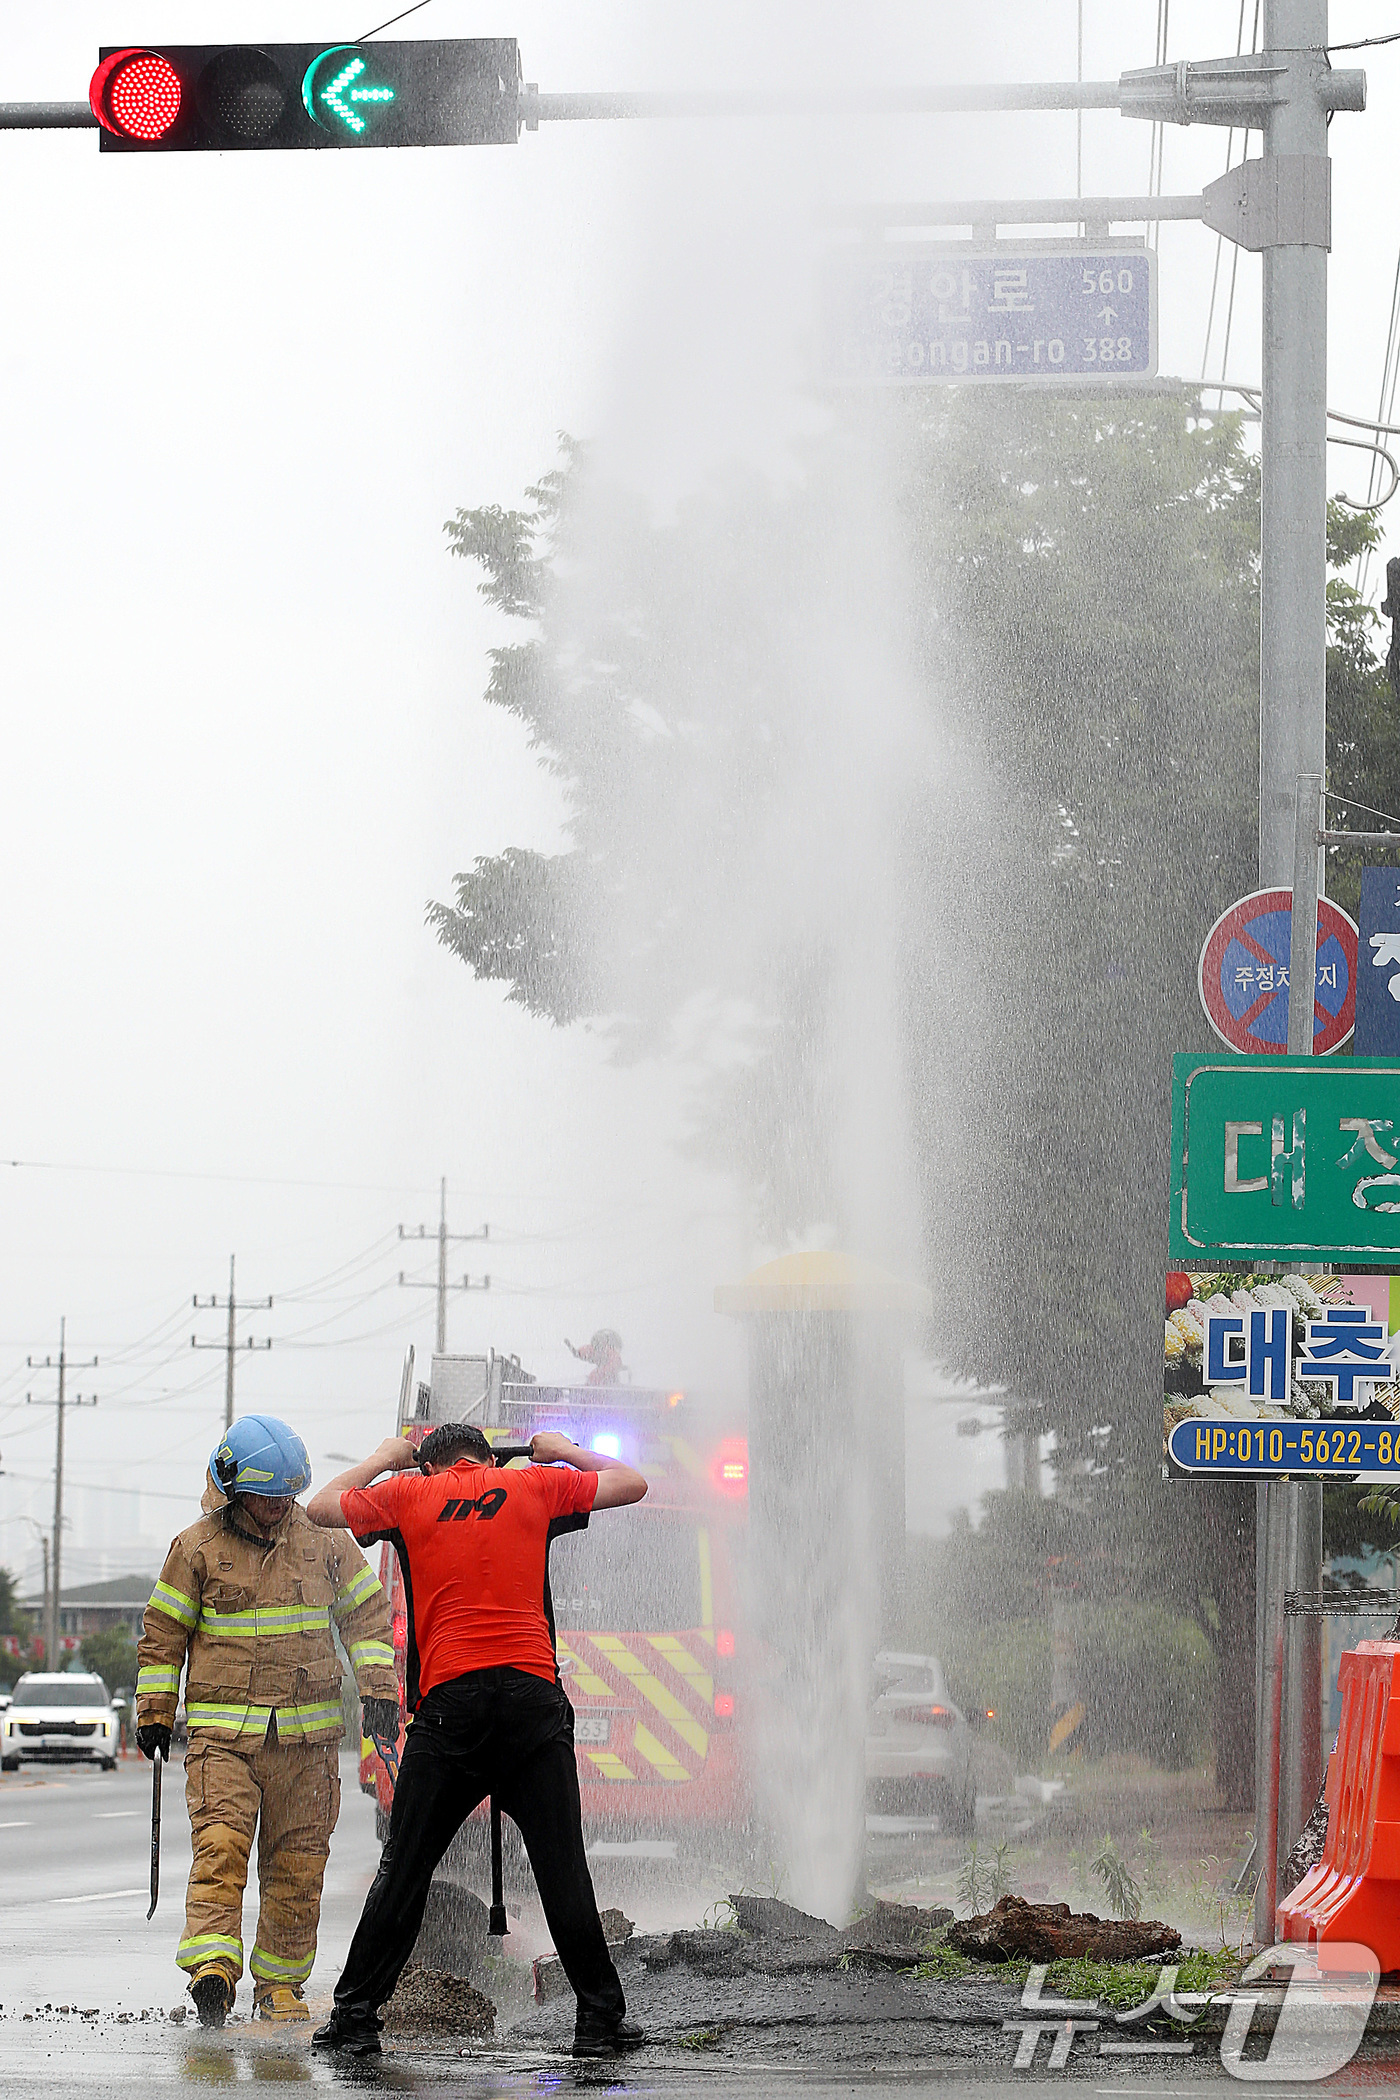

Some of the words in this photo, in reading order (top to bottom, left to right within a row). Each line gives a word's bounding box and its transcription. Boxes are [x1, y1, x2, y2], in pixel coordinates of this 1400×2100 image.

[1081, 269, 1134, 296] 560
[1081, 337, 1133, 363] 388
[1234, 962, 1337, 992] 주정차지
[1205, 1306, 1394, 1404] 대추
[437, 1487, 508, 1522] 119
